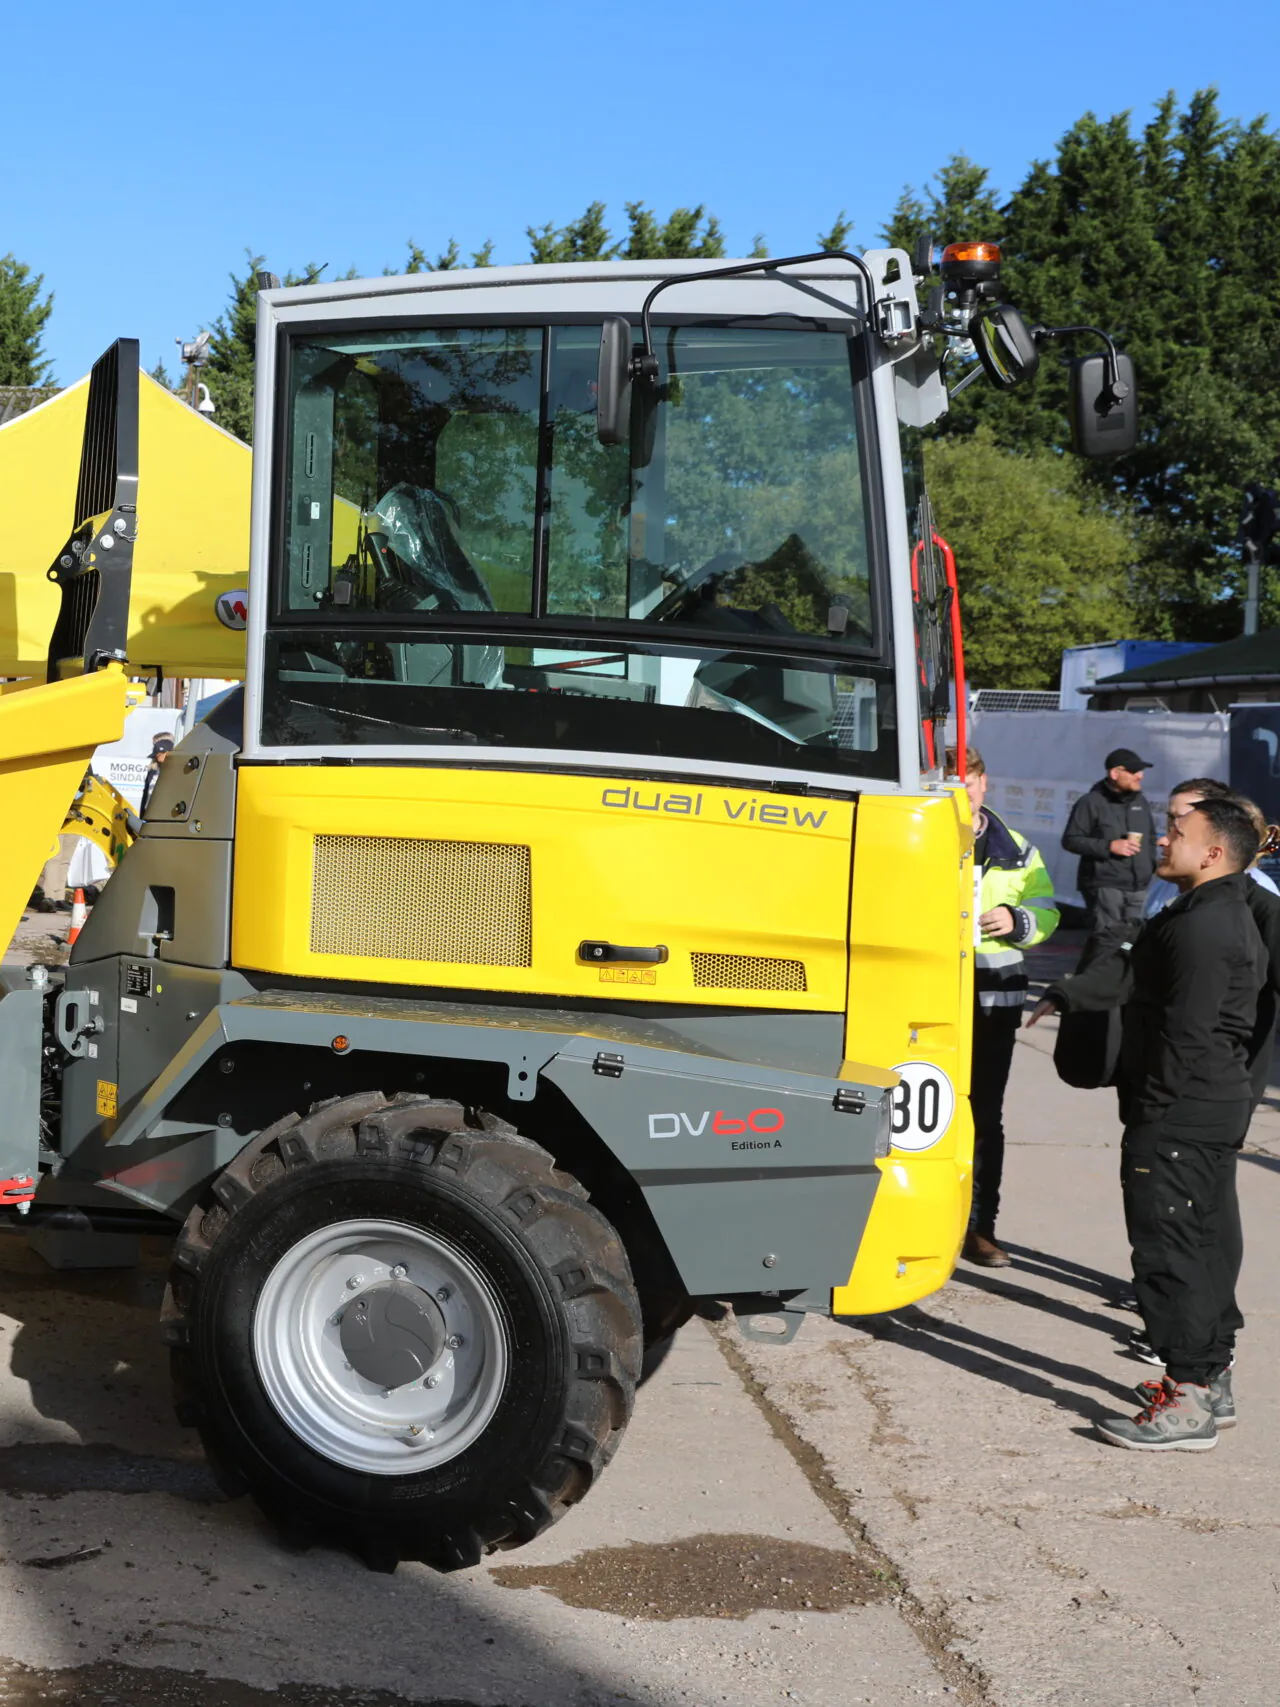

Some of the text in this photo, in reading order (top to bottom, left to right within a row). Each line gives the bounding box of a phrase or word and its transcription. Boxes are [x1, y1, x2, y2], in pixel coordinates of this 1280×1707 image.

[110, 763, 149, 773] MORGA
[601, 787, 828, 829] dual view
[891, 1078, 940, 1134] 30
[648, 1108, 785, 1139] DV60
[731, 1140, 782, 1151] Edition A
